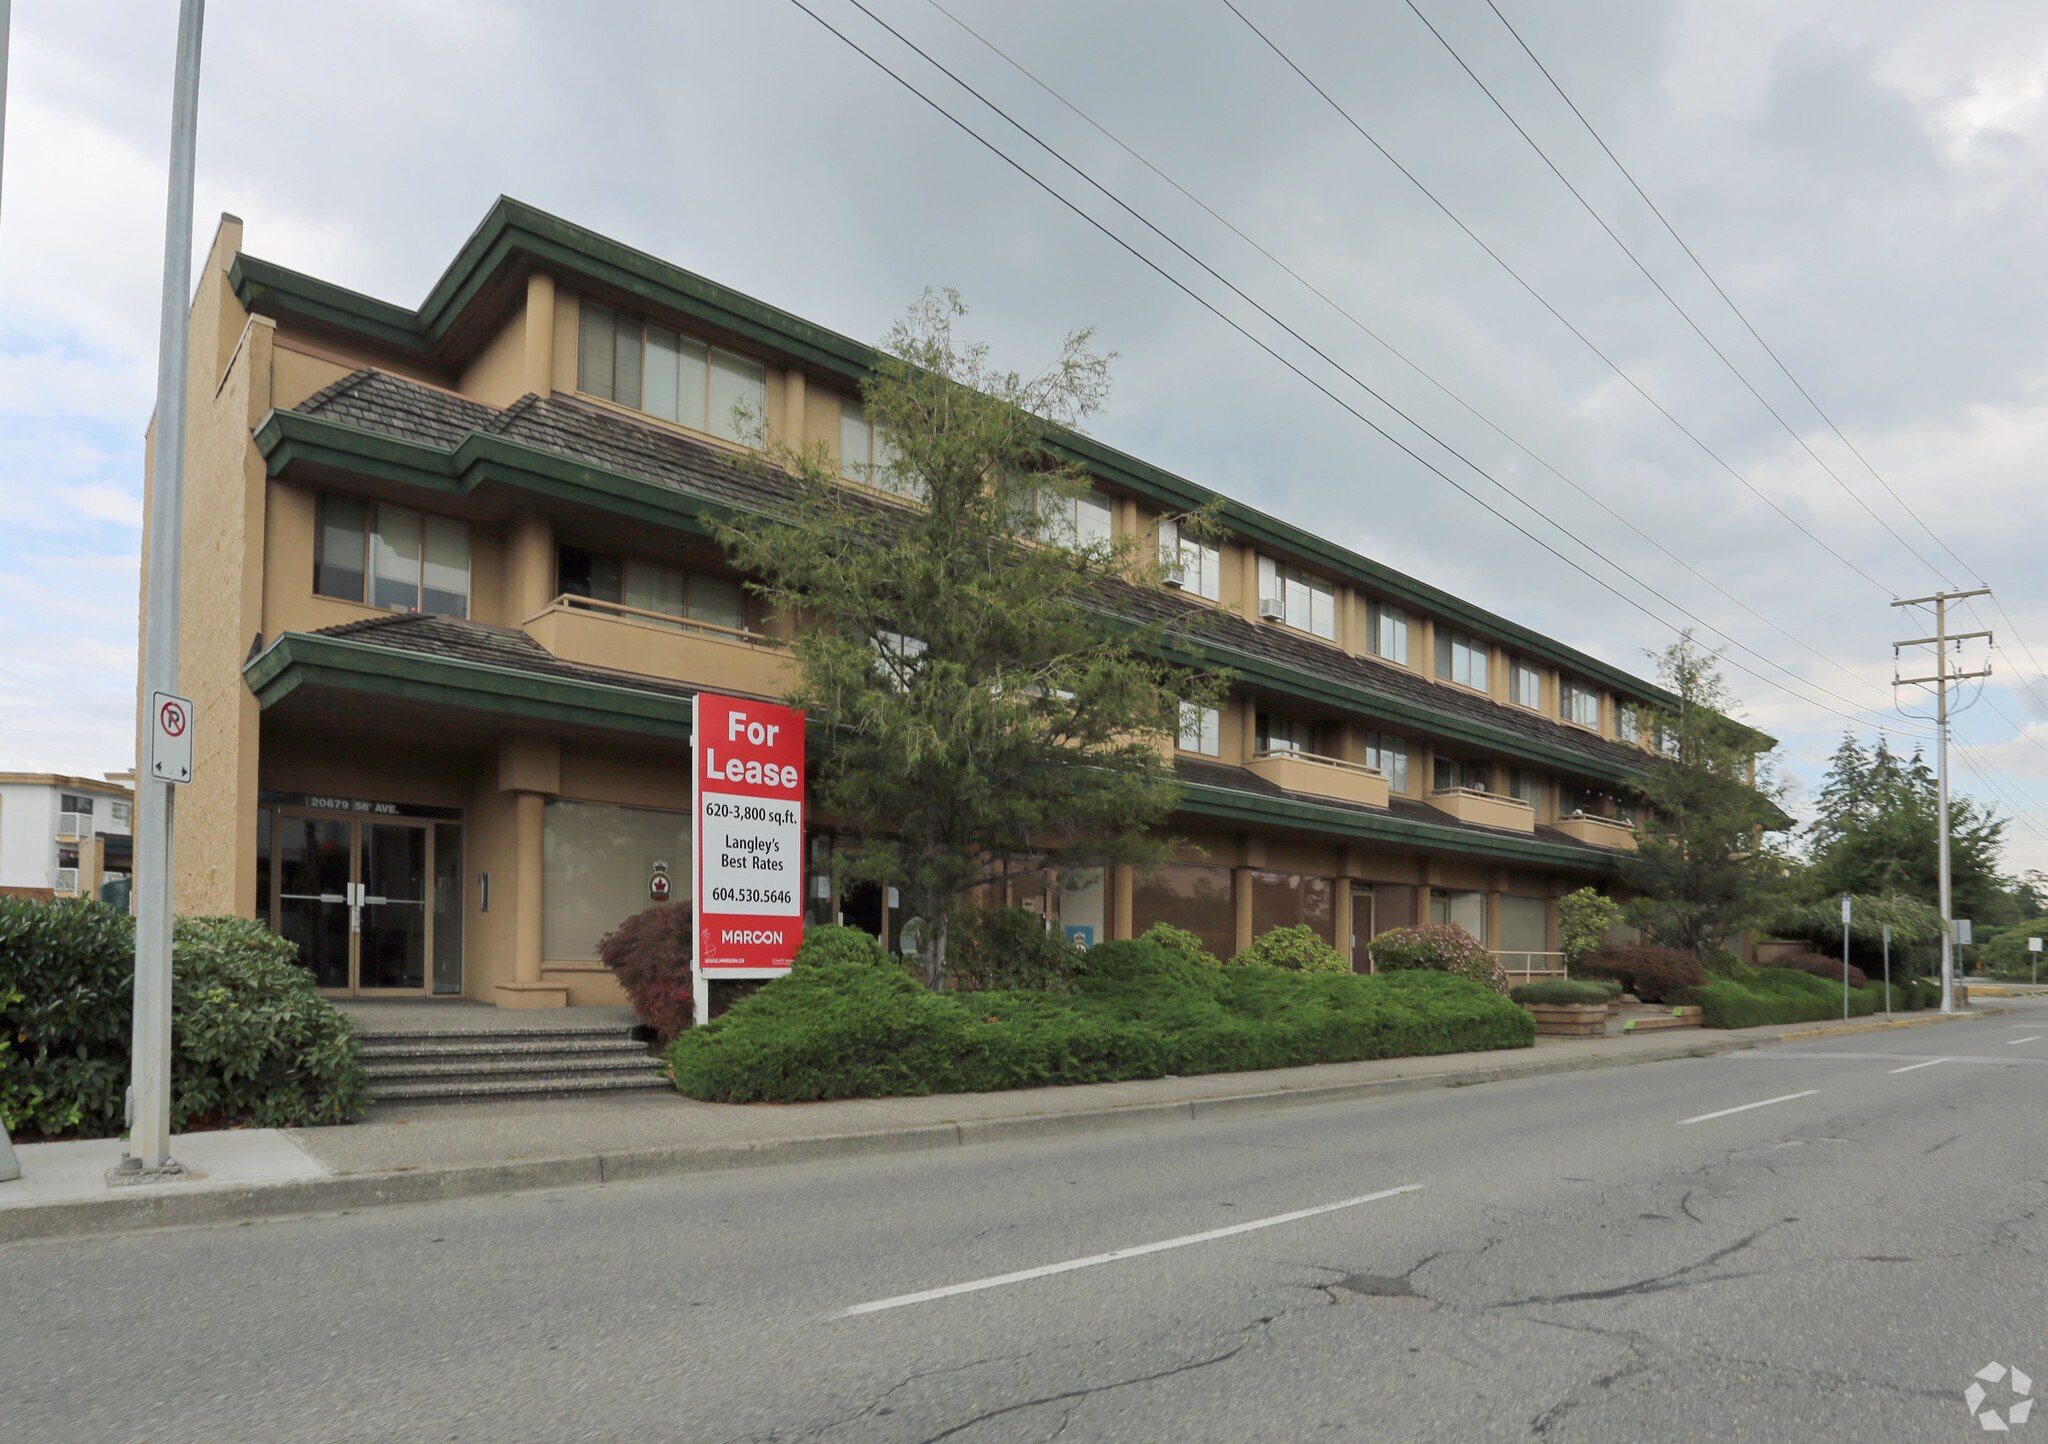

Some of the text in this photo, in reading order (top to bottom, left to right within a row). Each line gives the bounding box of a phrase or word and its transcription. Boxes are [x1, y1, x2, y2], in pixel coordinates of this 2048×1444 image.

[728, 710, 780, 747] For
[706, 747, 798, 789] Lease
[311, 797, 349, 809] 20679
[375, 803, 399, 814] AVE.
[706, 802, 797, 827] 620-3,800 sq.ft.
[725, 834, 780, 855] Langley's
[721, 853, 784, 871] Best Rates
[712, 887, 791, 904] 604.530.5646
[721, 929, 783, 945] MARCON
